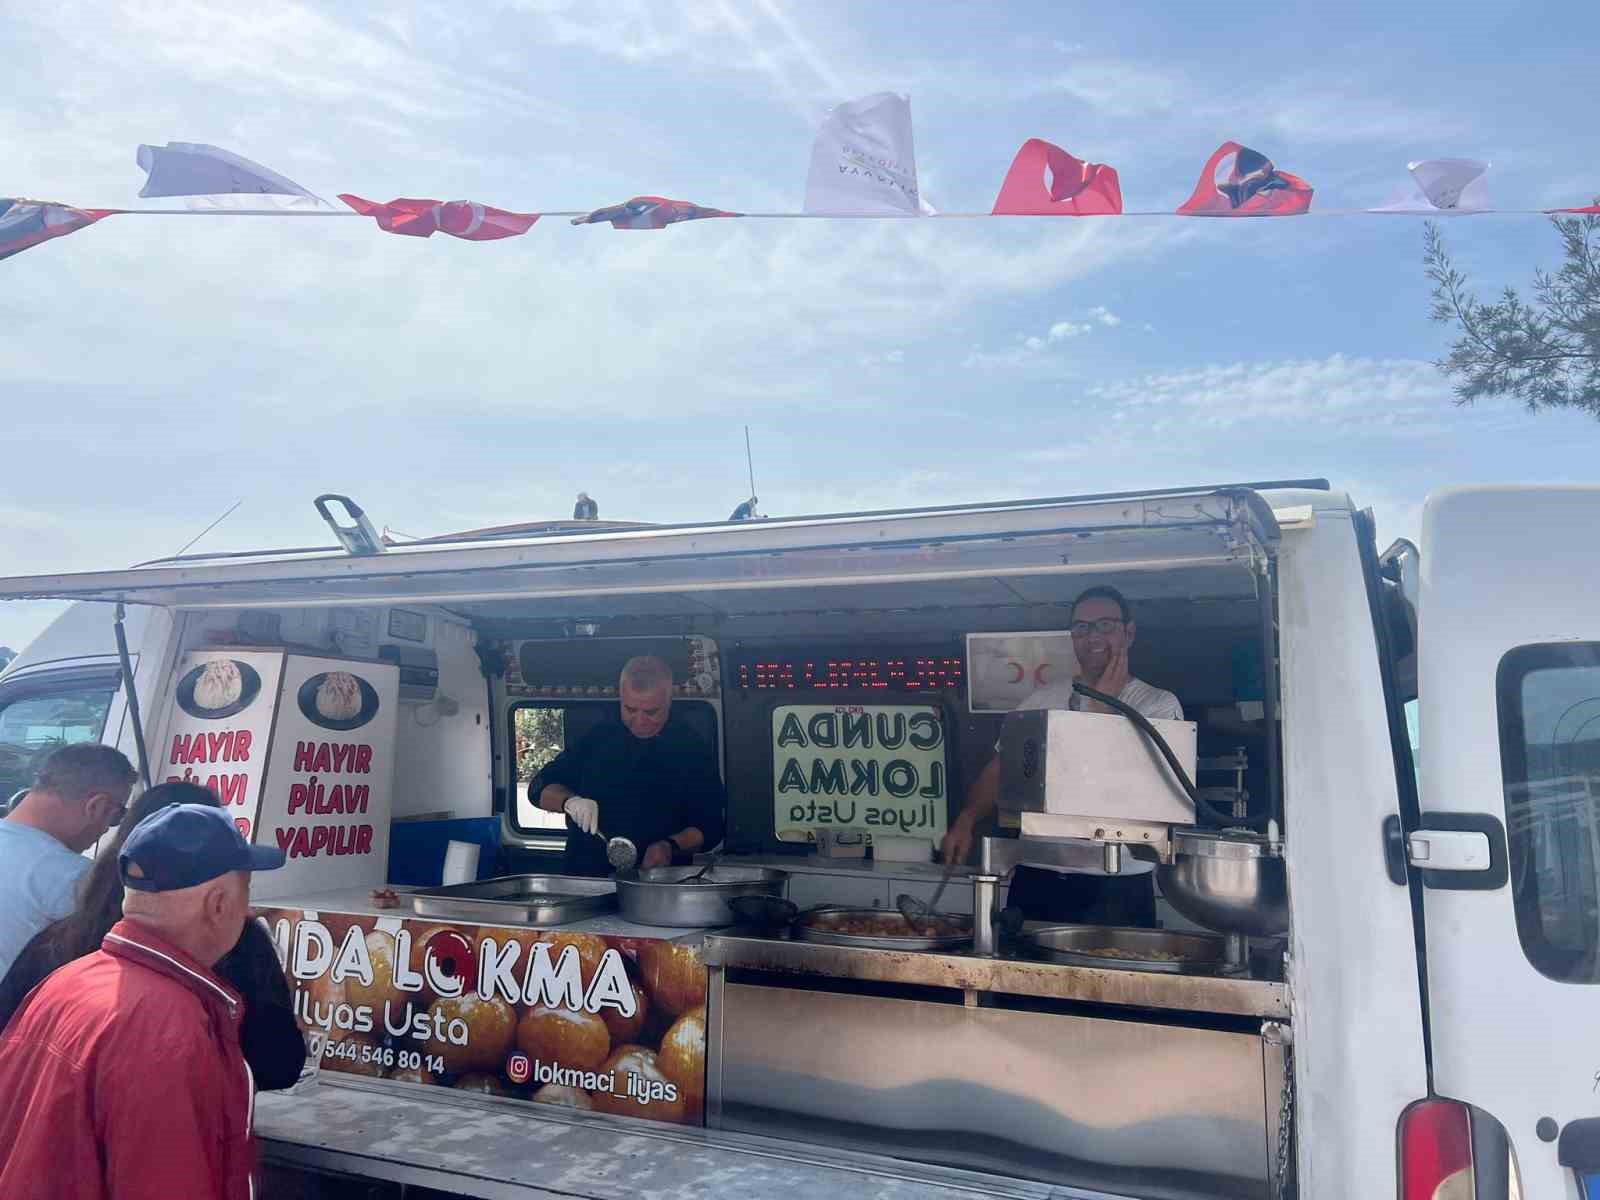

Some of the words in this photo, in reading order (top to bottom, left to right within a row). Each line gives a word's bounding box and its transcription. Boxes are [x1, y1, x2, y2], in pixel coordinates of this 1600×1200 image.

[170, 730, 252, 764] HAYIR
[293, 741, 373, 774] HAYIR
[288, 776, 370, 815] PİLAVI
[276, 825, 373, 858] YAPILIR
[256, 916, 374, 987] NDA
[392, 928, 637, 1019] LOKMA
[384, 999, 469, 1046] Usta
[325, 1040, 357, 1061] 544
[361, 1045, 394, 1066] 546
[398, 1051, 421, 1070] 80
[425, 1054, 445, 1074] 14
[533, 1059, 678, 1104] lokmaci_ilyas
